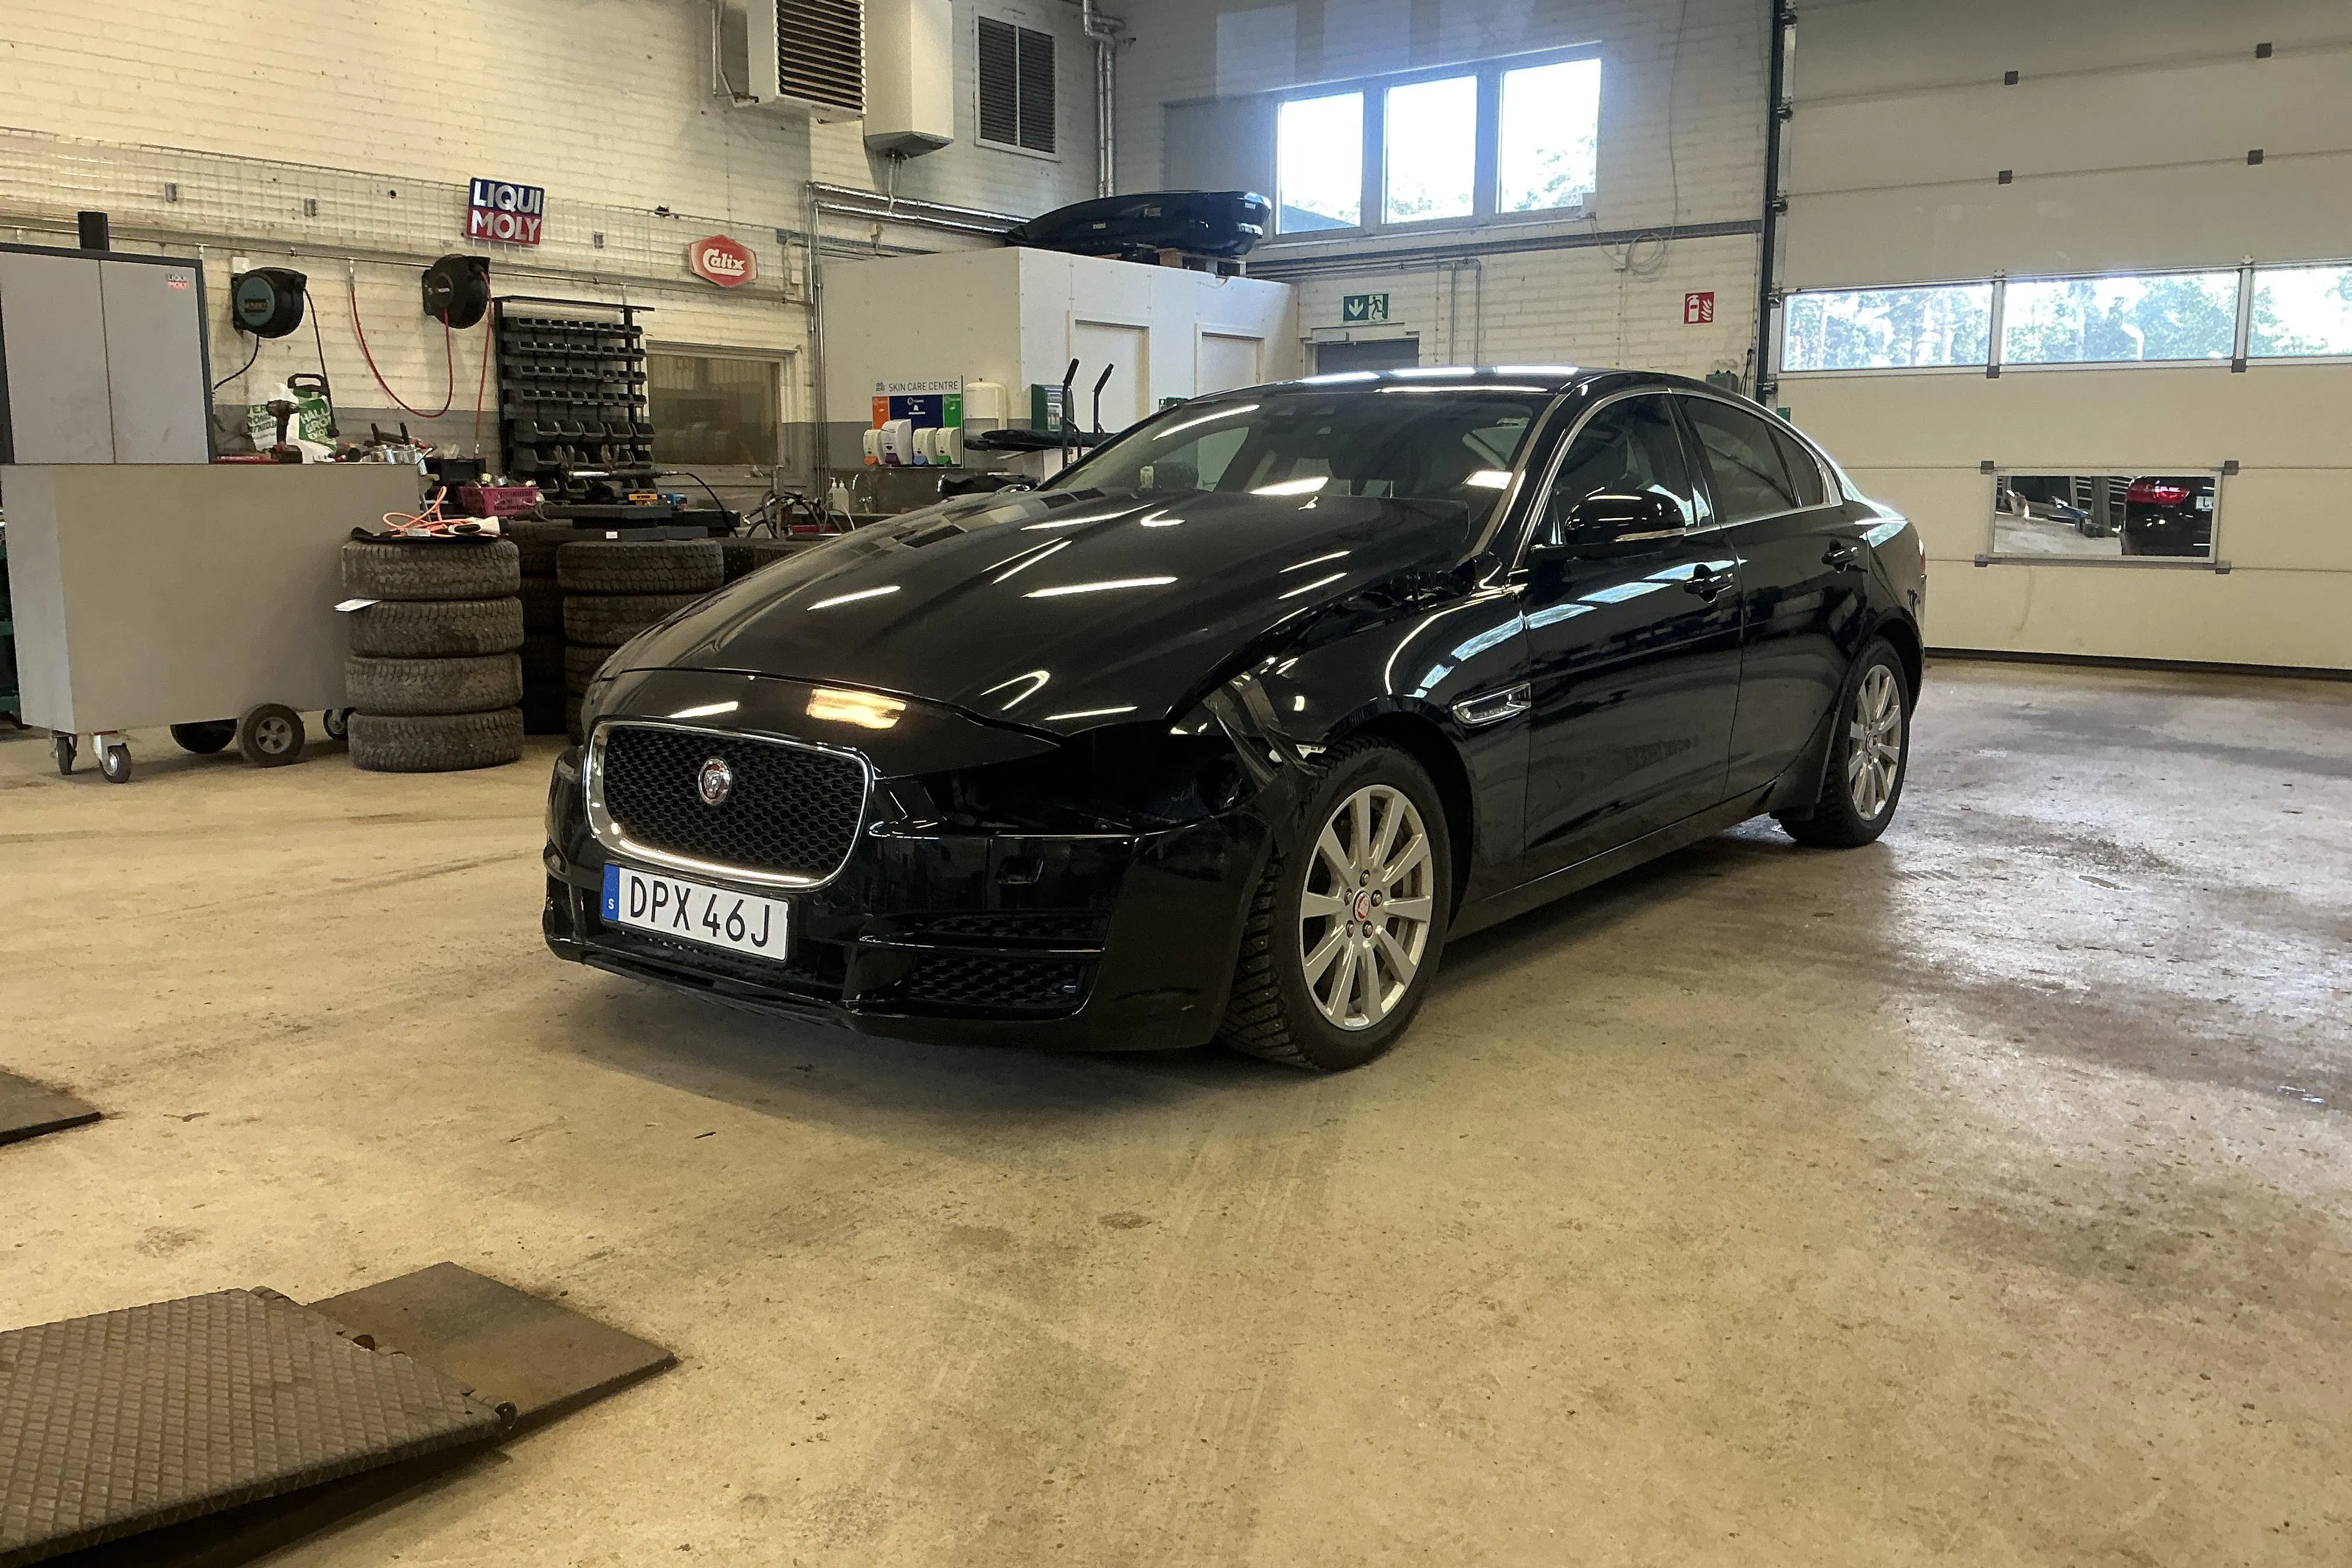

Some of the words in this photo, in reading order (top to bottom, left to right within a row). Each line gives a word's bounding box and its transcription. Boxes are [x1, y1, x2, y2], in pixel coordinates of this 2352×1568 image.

[473, 181, 541, 214] LIQUI
[471, 209, 541, 242] MOLY
[702, 248, 746, 276] Calix
[888, 383, 905, 392] SKIN
[908, 382, 927, 391] CARE
[929, 380, 958, 390] CENTRE
[608, 898, 614, 910] S
[630, 876, 691, 931] DPX
[702, 894, 770, 947] 46J
